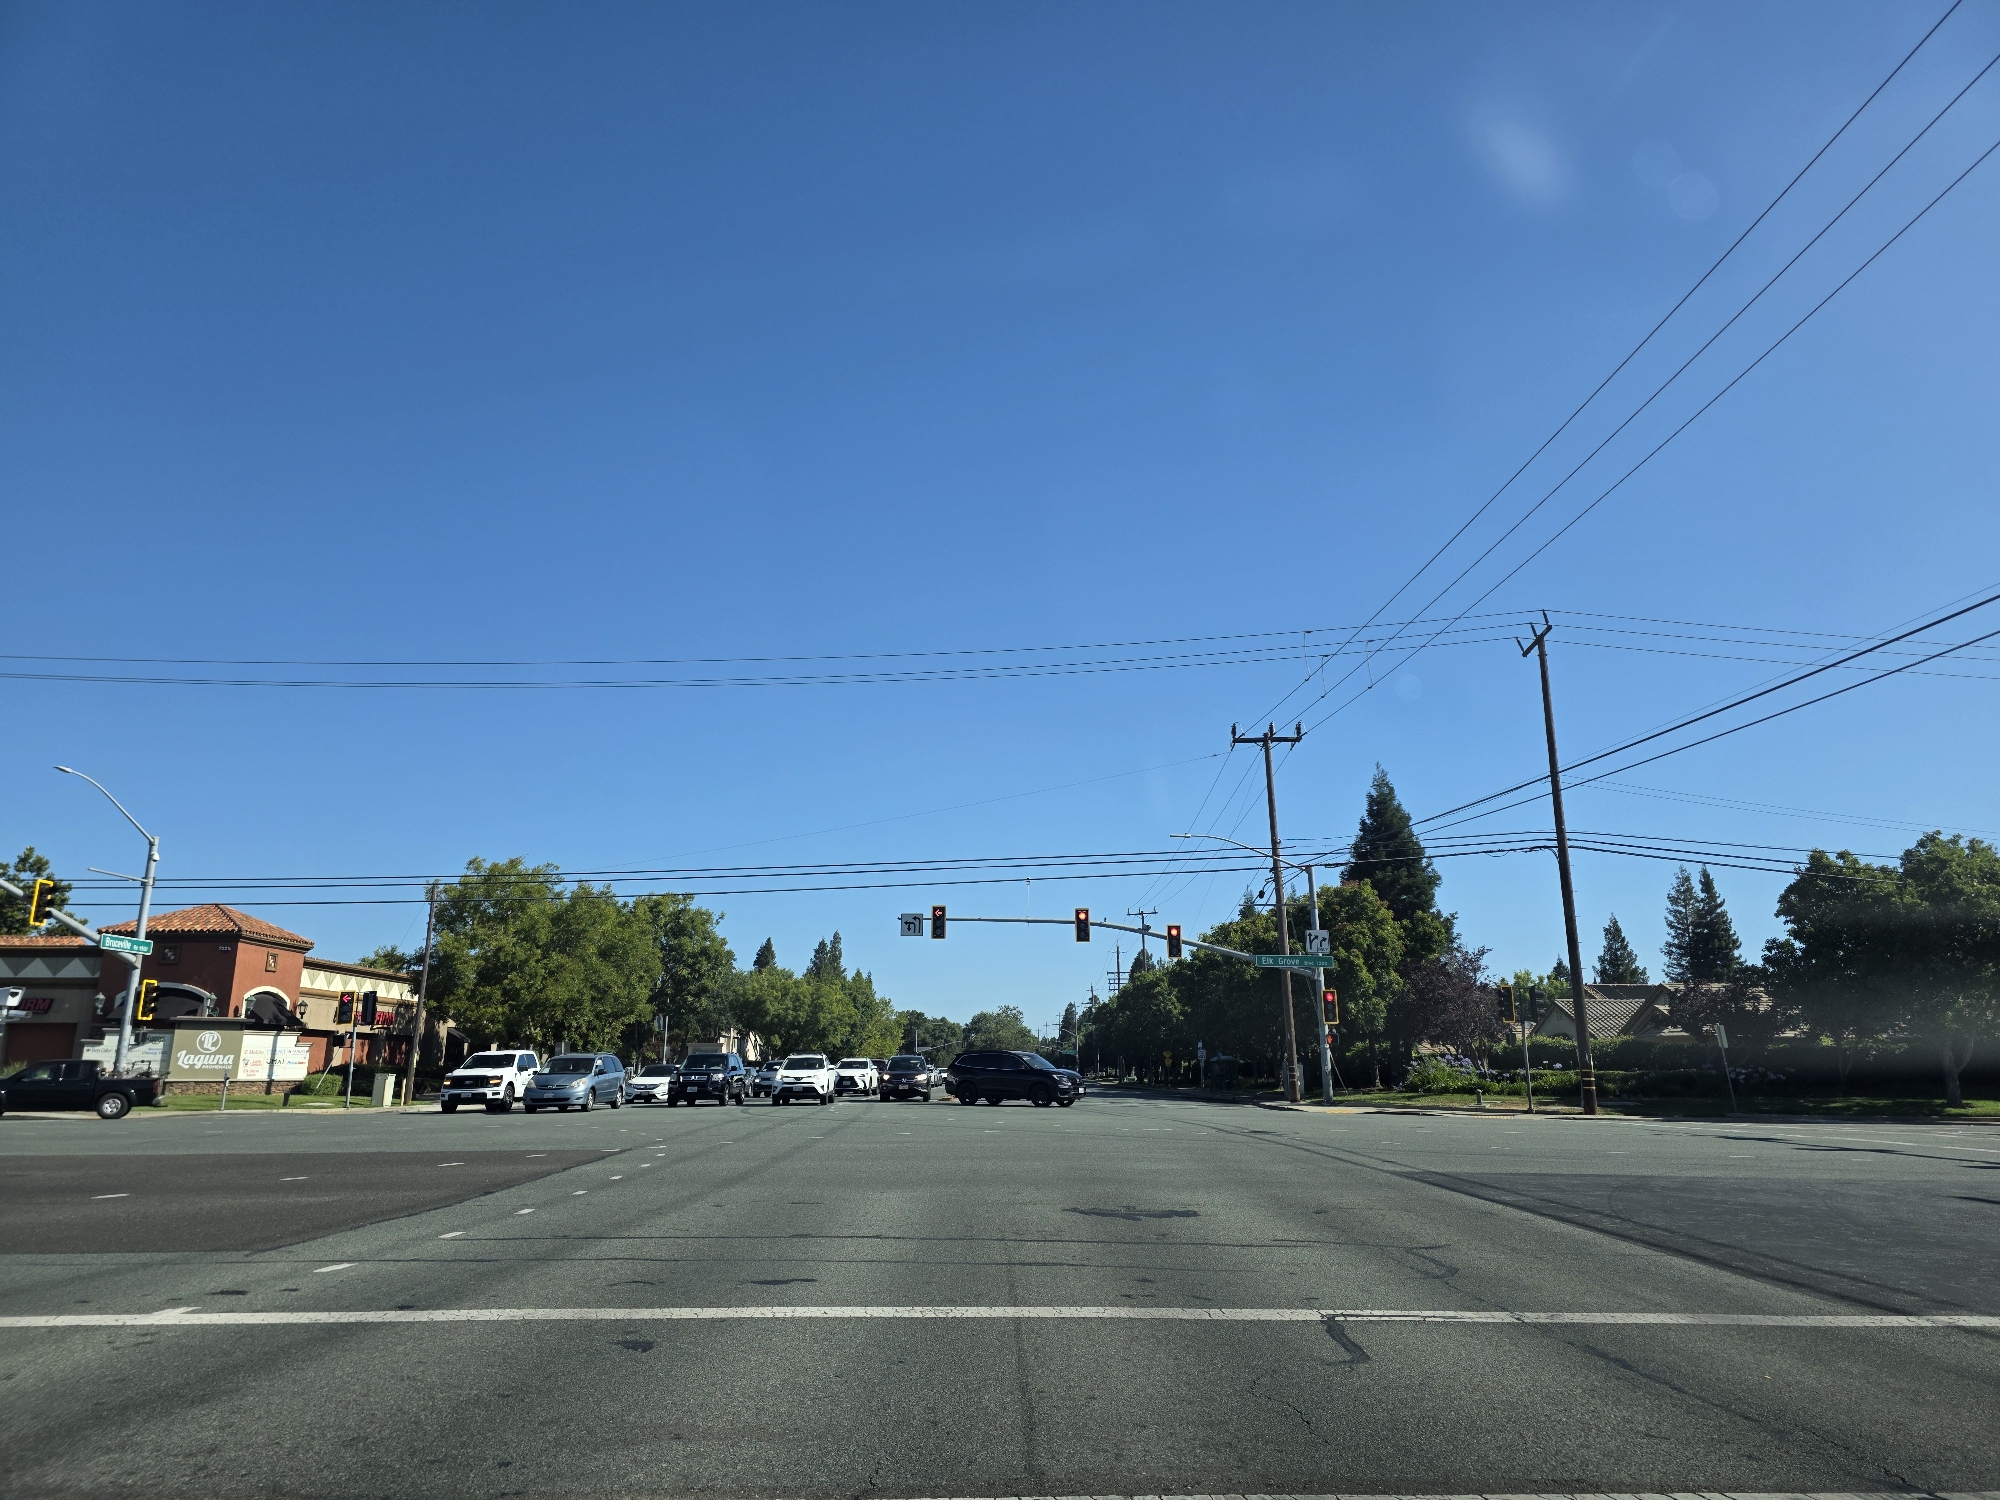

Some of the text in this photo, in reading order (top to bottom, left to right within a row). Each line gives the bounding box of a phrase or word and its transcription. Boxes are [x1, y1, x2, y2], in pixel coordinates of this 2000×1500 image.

[105, 936, 132, 950] Bruceville
[1262, 957, 1274, 965] Elk
[1278, 957, 1300, 965] Grove
[177, 1050, 235, 1069] Laguna
